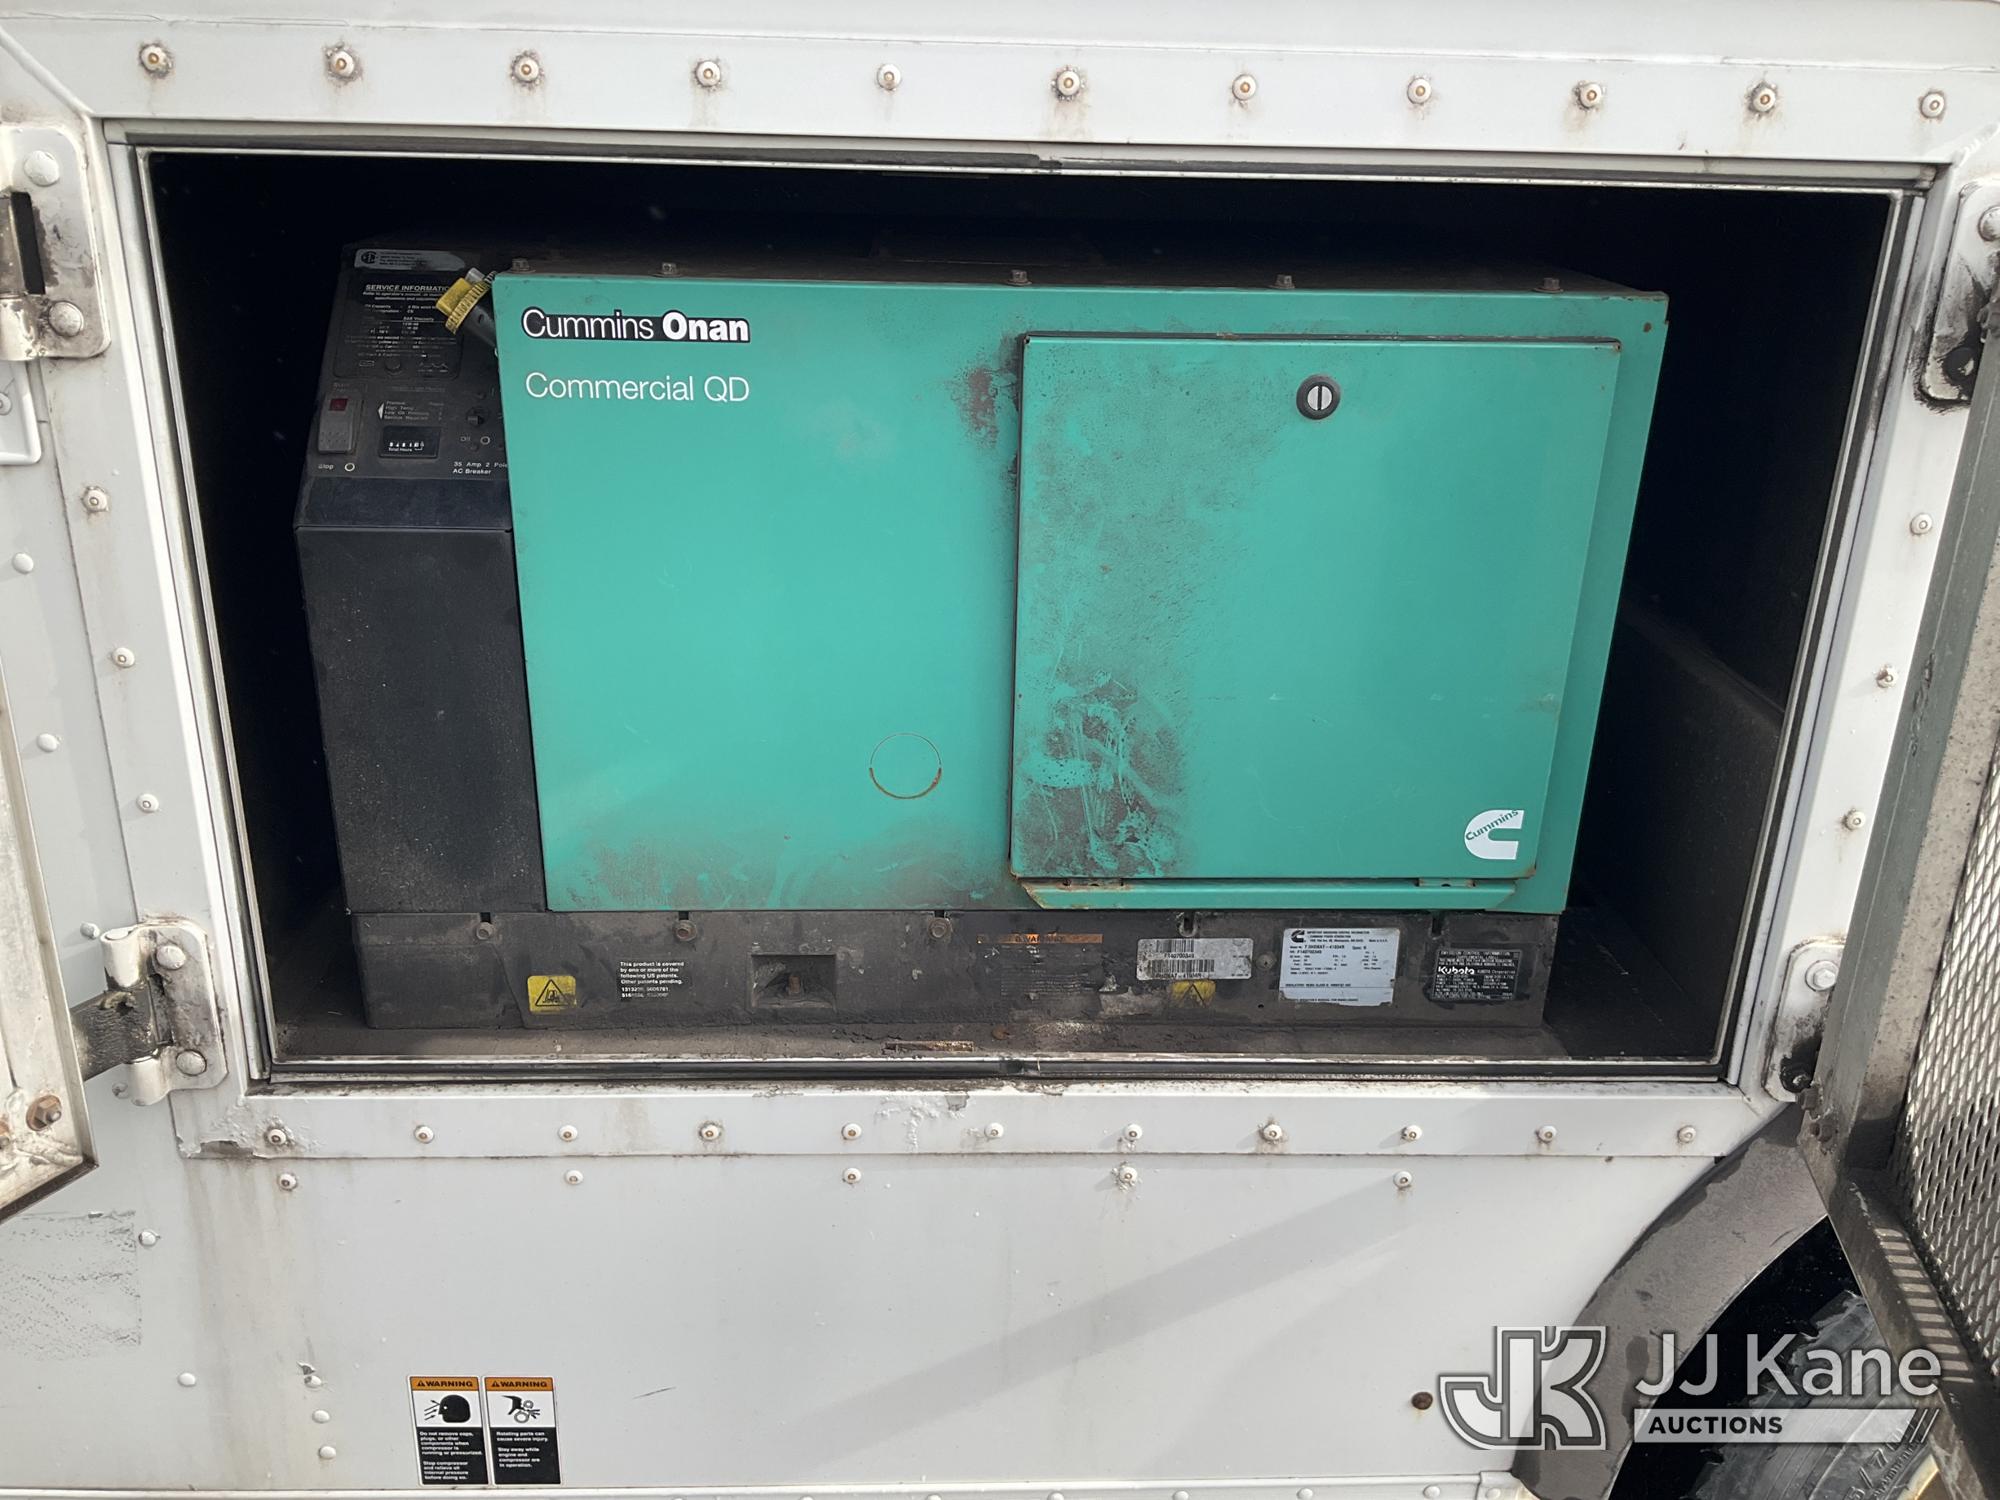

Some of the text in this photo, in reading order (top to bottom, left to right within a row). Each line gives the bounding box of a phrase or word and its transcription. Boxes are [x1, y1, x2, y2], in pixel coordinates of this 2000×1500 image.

[523, 309, 750, 341] Cummins Onan
[525, 372, 750, 402] Commercial QD
[1466, 809, 1518, 840] Cummins
[1438, 966, 1475, 974] Kubota
